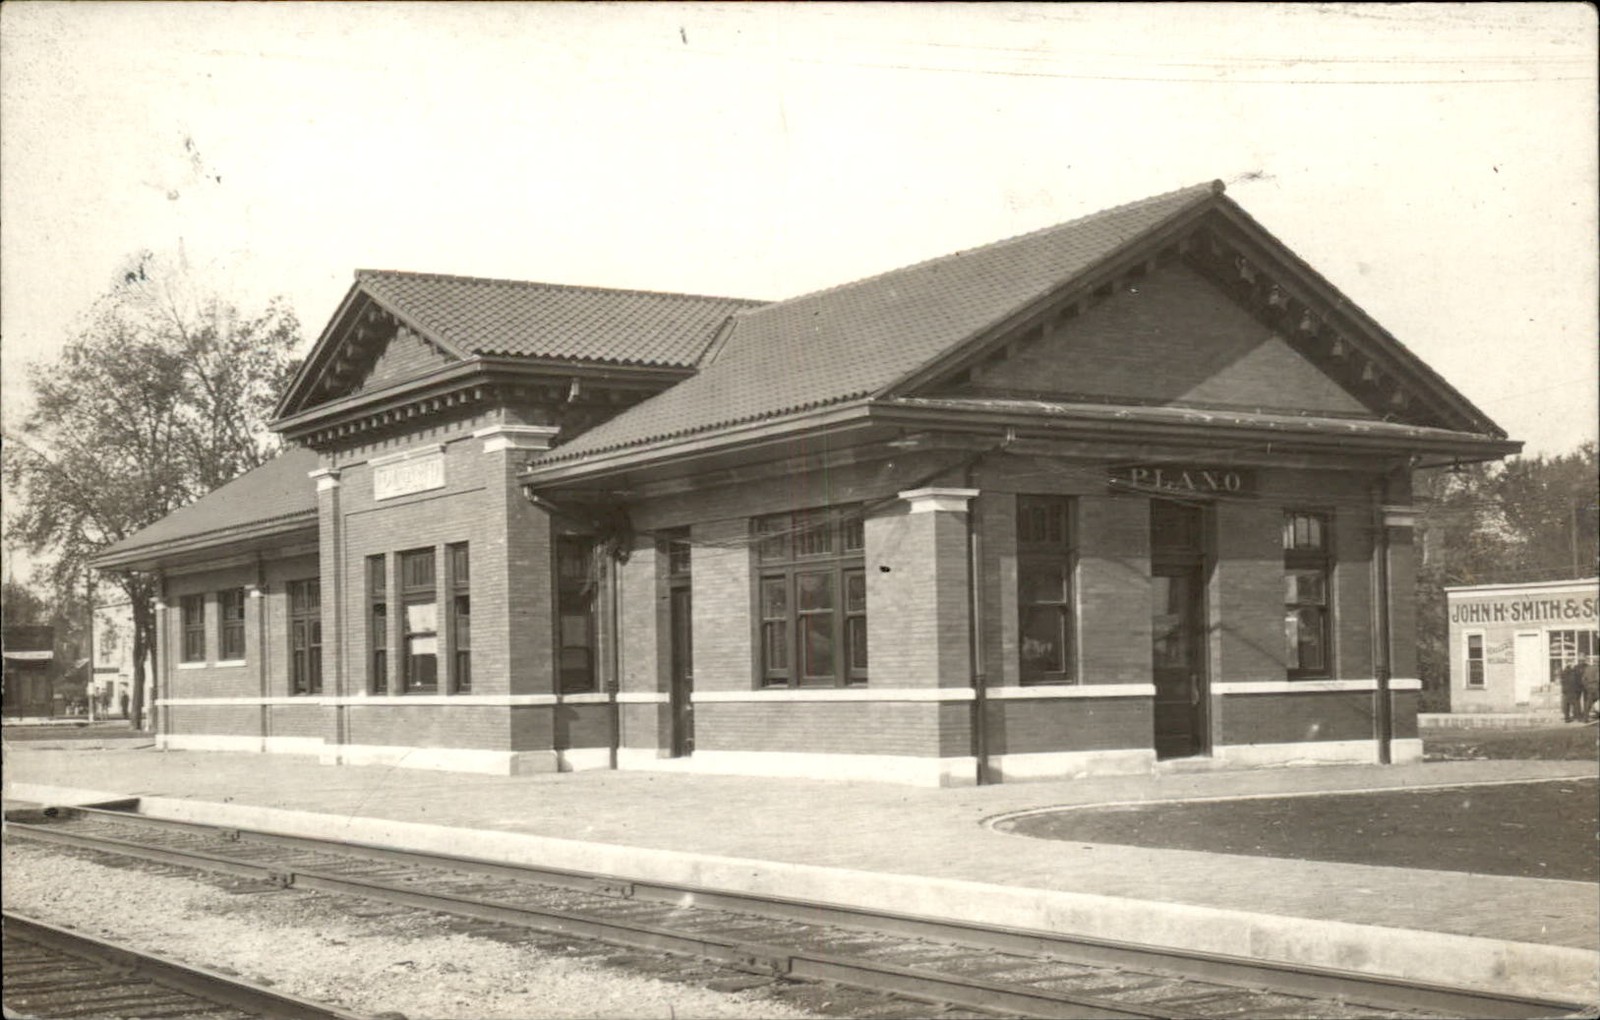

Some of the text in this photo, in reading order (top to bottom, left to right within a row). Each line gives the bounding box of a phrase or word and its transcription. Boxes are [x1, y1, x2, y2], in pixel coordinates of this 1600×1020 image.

[1131, 468, 1241, 491] PLANO
[1452, 603, 1491, 623] JOHN
[1511, 600, 1561, 621] SMITH
[1563, 598, 1580, 619] &
